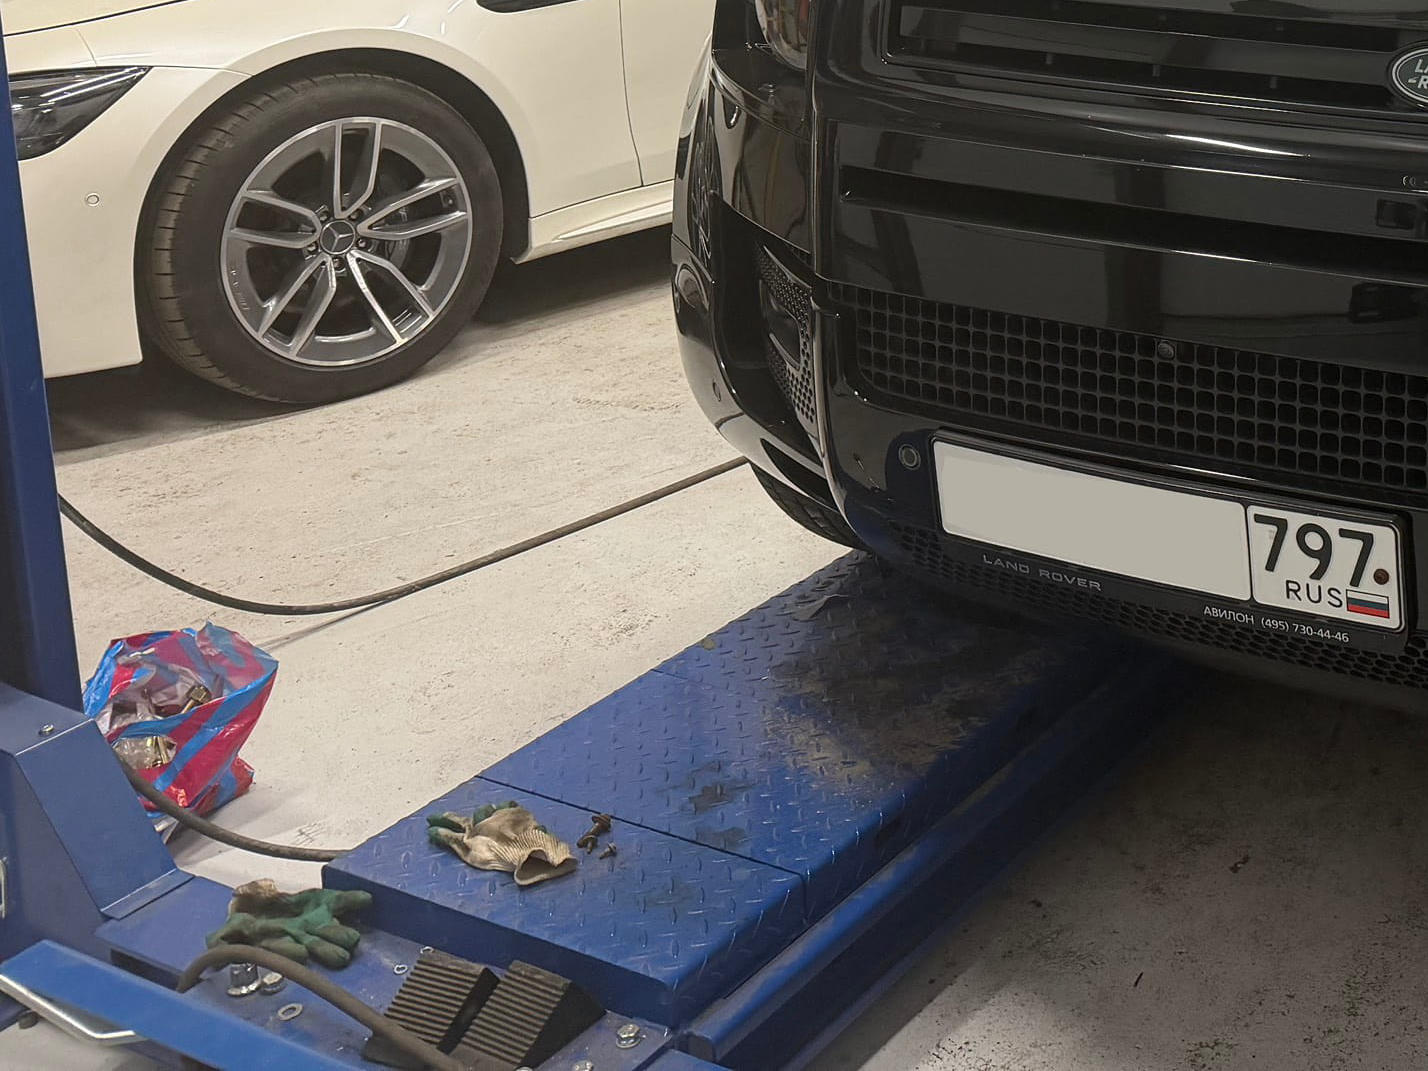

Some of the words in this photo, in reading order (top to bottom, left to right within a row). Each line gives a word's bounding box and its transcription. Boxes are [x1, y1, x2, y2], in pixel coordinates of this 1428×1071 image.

[1253, 513, 1374, 588] 797
[982, 553, 1030, 575] LAND
[1038, 568, 1102, 591] ROVER
[1285, 579, 1343, 609] RUS
[1203, 605, 1255, 625] АВИЛОН
[1261, 616, 1290, 633] (495)
[1292, 623, 1350, 643] 730-44-46
